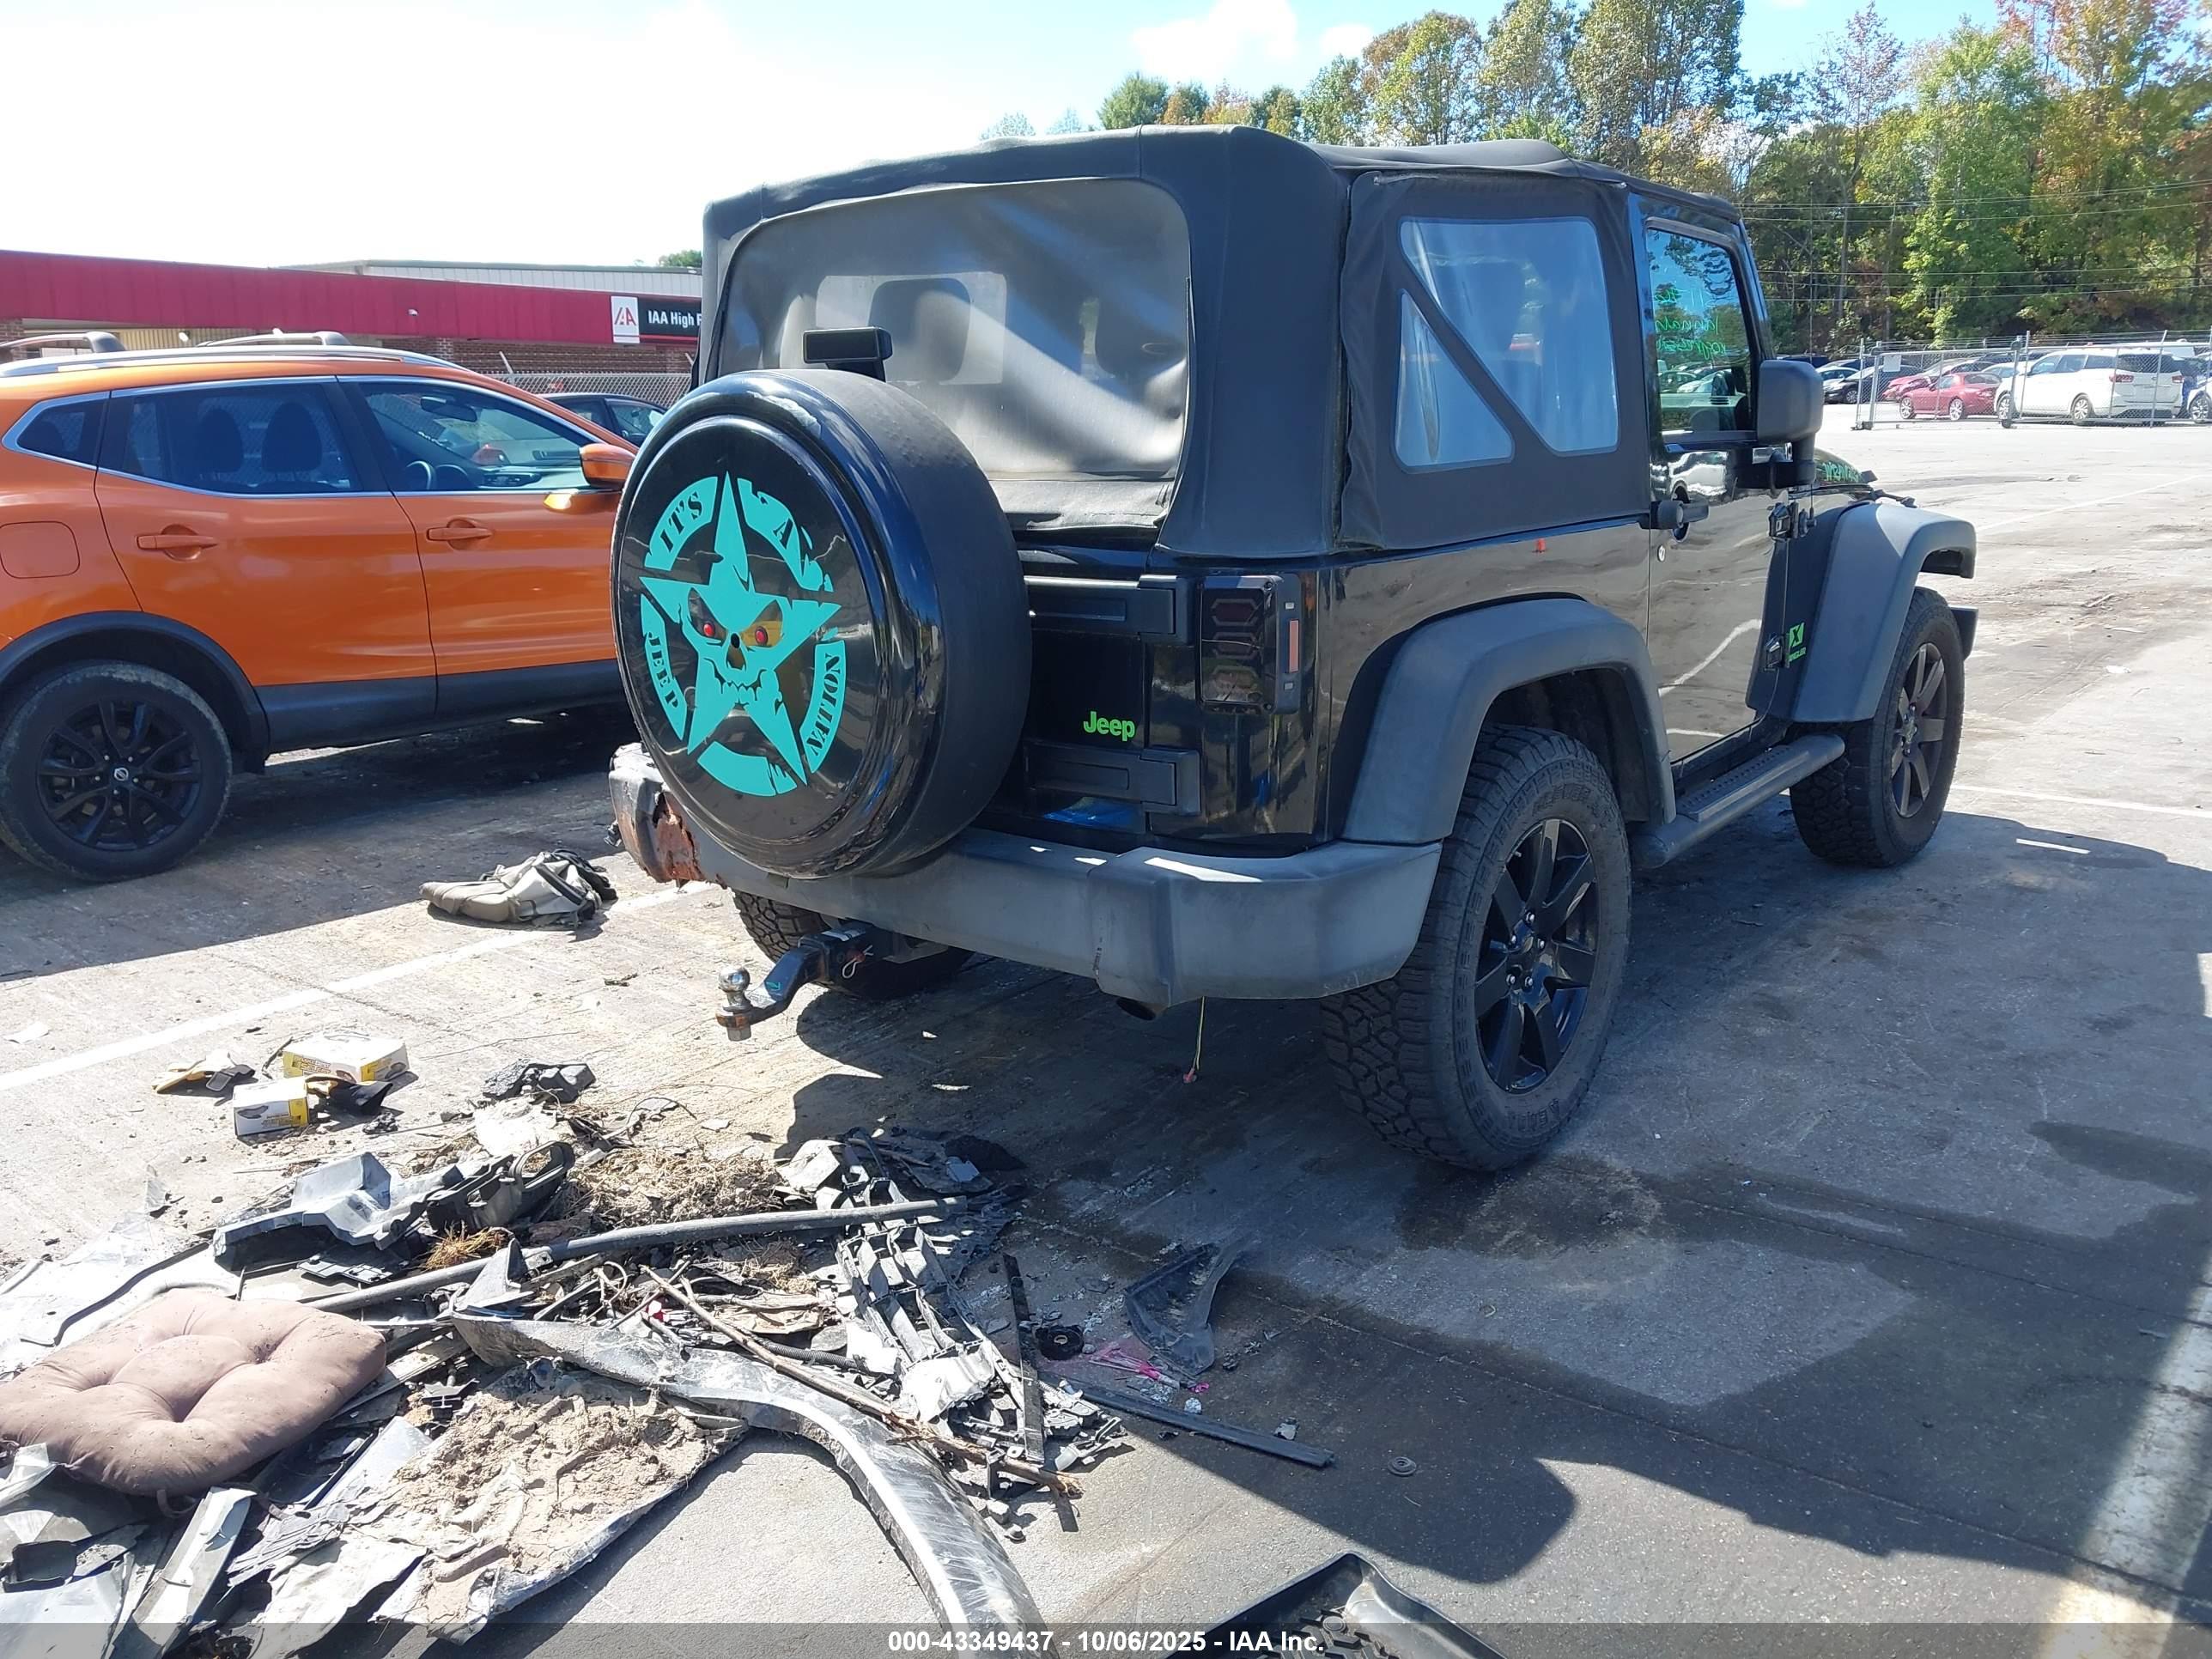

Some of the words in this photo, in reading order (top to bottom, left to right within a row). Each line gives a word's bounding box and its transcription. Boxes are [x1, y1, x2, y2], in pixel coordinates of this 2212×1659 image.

[648, 310, 668, 325] IAA
[670, 311, 694, 328] High
[660, 491, 703, 552] IT'S
[773, 518, 794, 547] A
[645, 631, 679, 709] JEEP
[806, 653, 842, 757] NATION
[1083, 710, 1135, 742] Jeep
